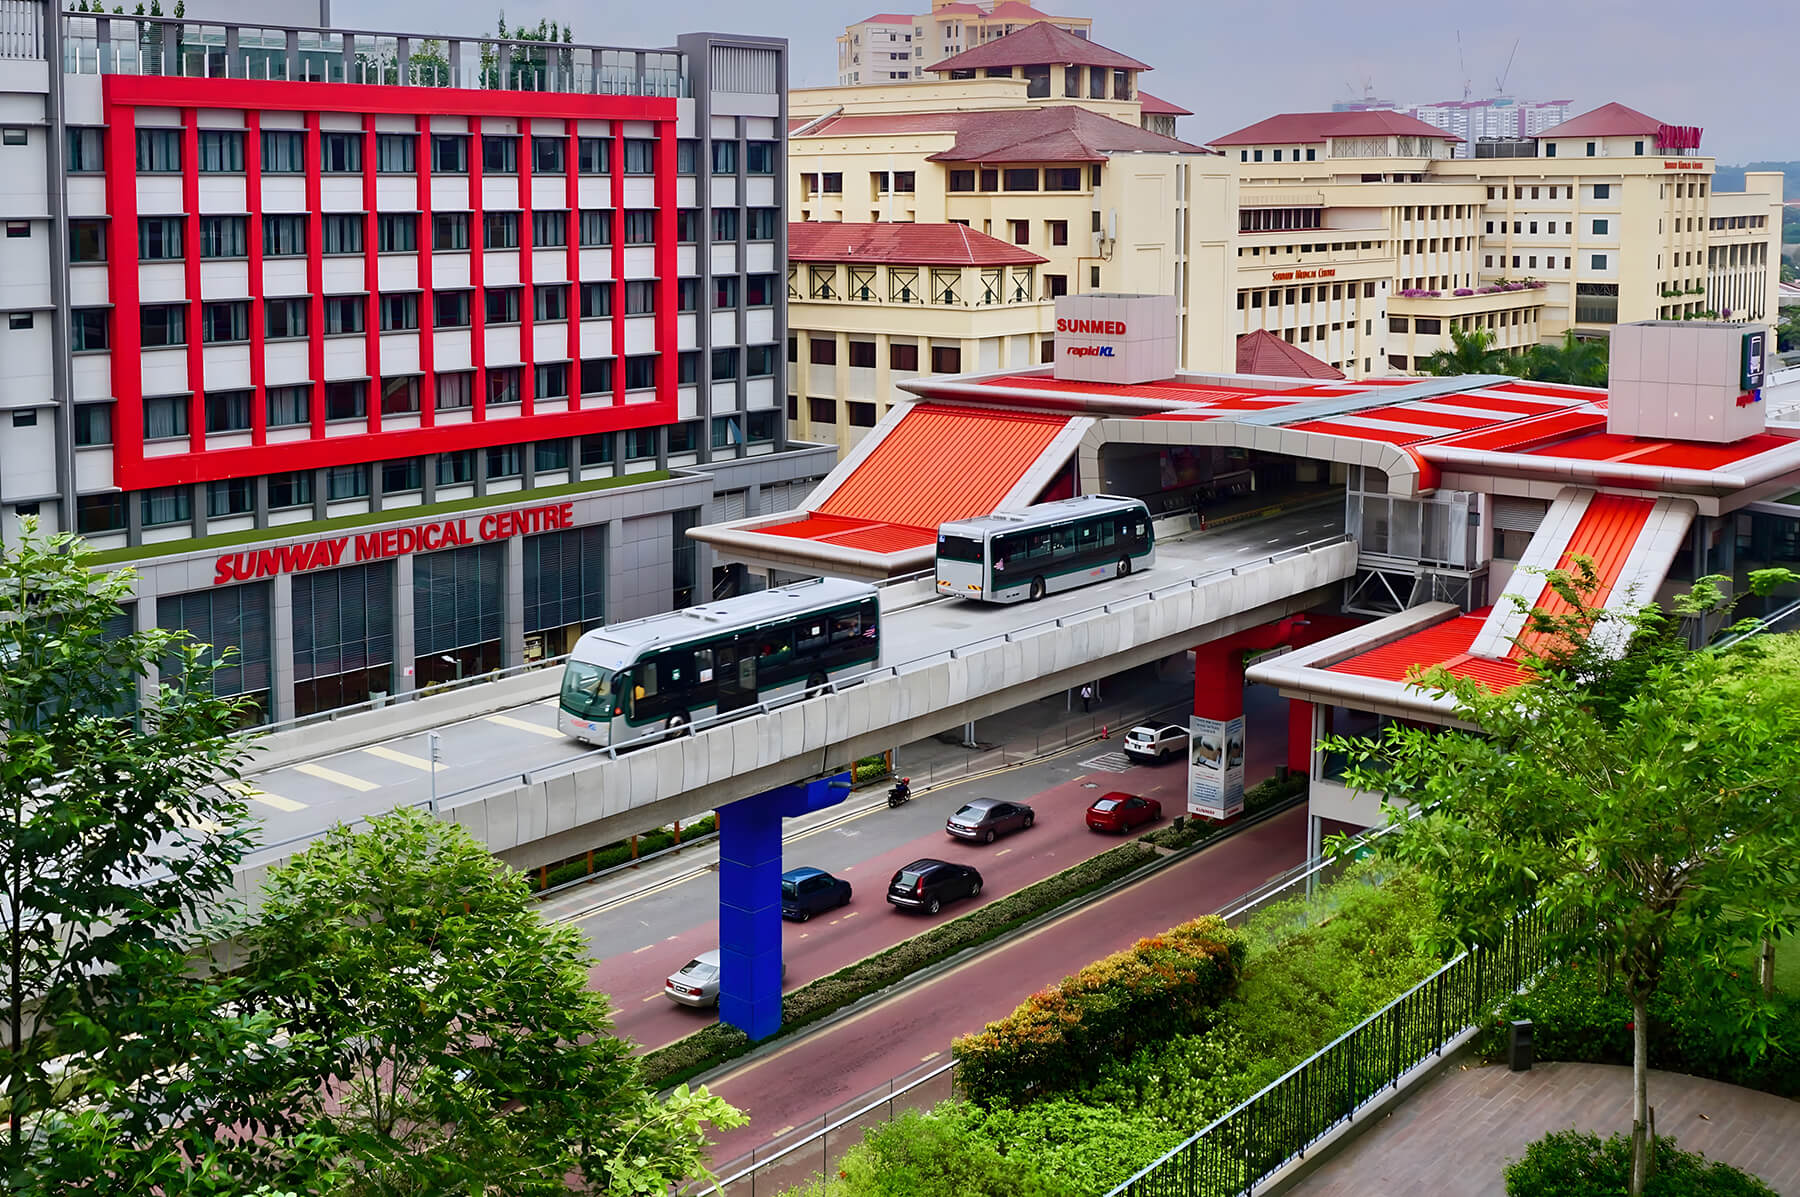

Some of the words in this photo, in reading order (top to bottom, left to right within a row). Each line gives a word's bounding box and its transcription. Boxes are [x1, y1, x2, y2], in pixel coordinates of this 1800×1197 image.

[1057, 318, 1126, 335] SUNMED
[1067, 345, 1115, 358] rapidKL
[214, 537, 349, 585] SUNWAY
[355, 519, 474, 562] MEDICAL
[479, 502, 574, 541] CENTRE
